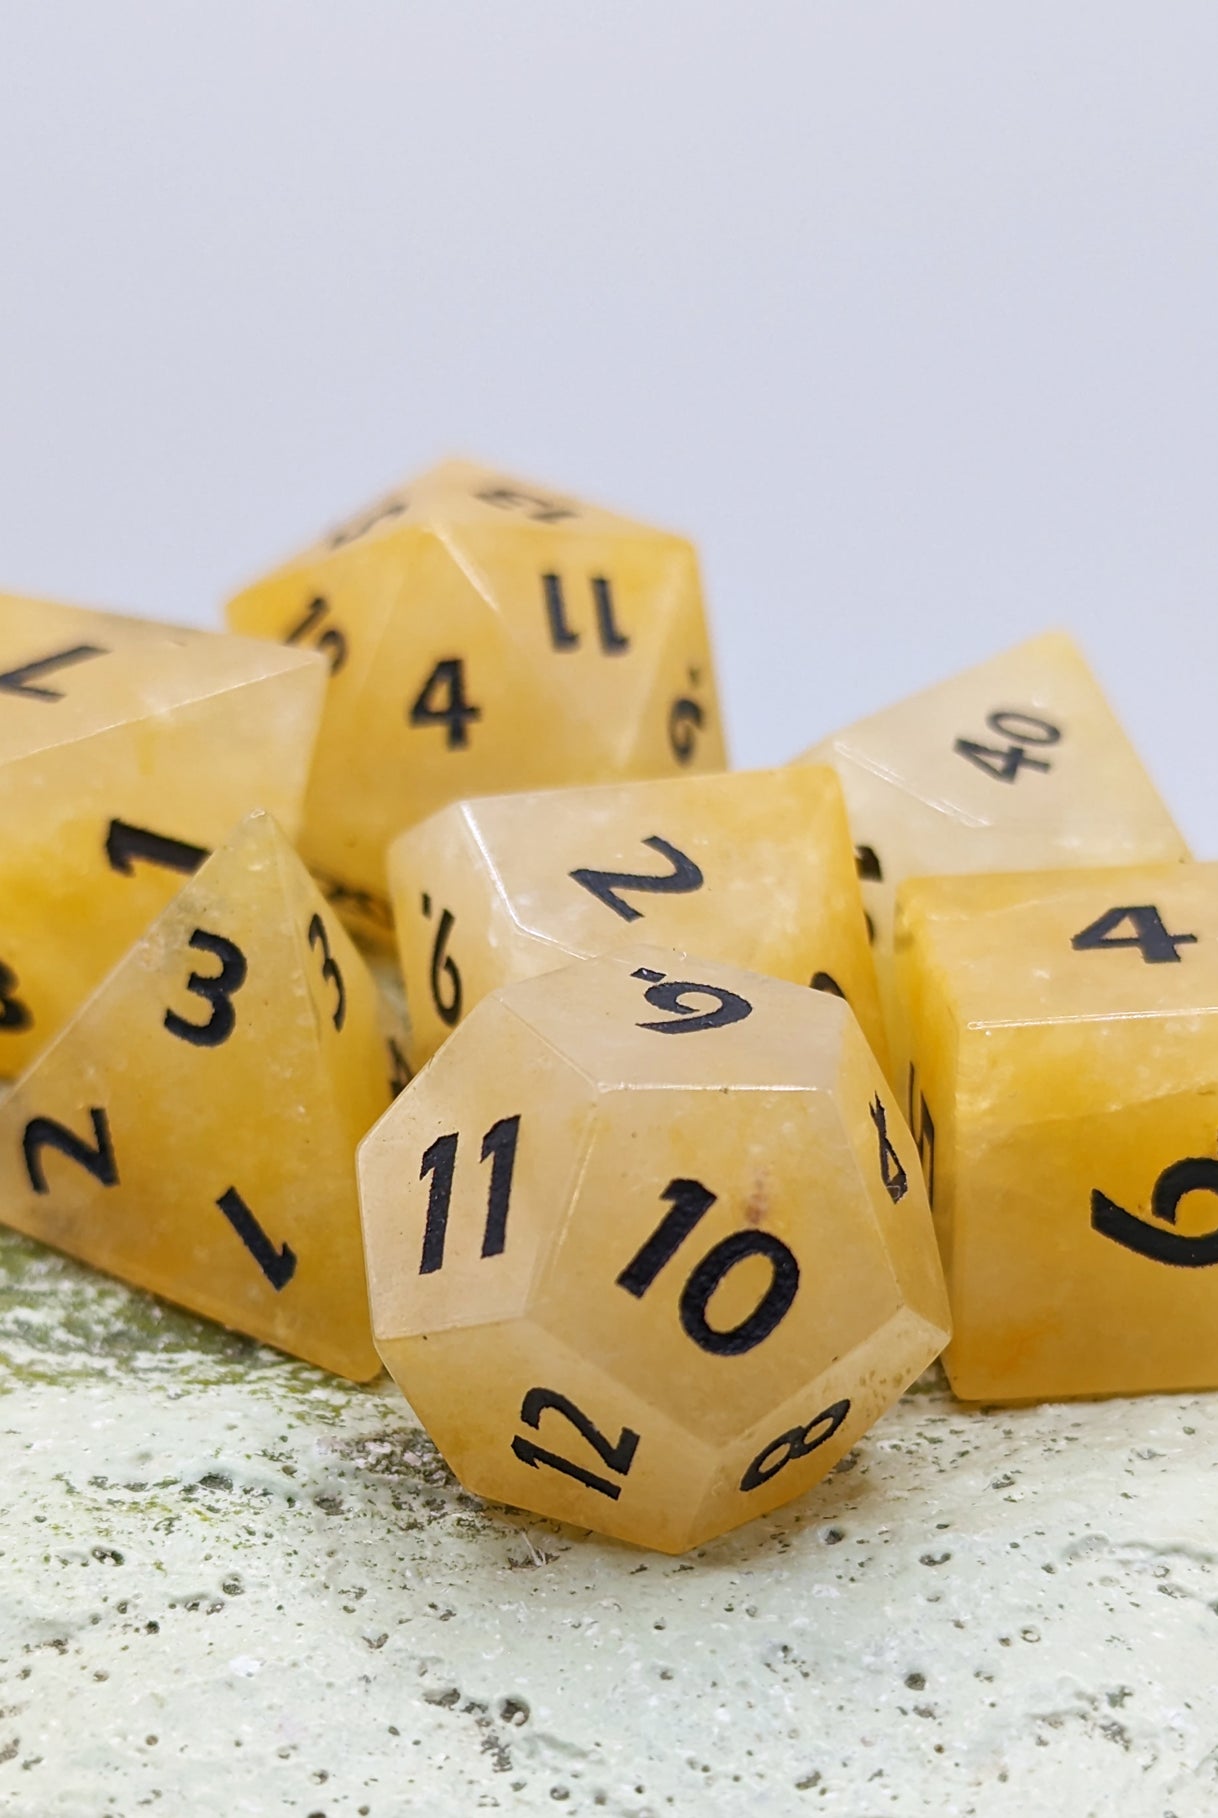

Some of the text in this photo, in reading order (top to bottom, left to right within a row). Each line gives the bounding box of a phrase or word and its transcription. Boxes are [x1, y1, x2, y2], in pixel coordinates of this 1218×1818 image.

[541, 573, 630, 656] 11
[408, 658, 482, 750] 4
[954, 711, 1063, 784] 40
[568, 834, 705, 923] 2
[307, 912, 346, 1033] 3
[1070, 904, 1200, 964] 4
[163, 927, 248, 1048] 3
[21, 1107, 120, 1195] 2
[418, 1113, 522, 1276] 11
[215, 1186, 298, 1292] 1
[615, 1177, 800, 1357] 10
[511, 1386, 641, 1501] 12
[739, 1398, 851, 1492] 8
